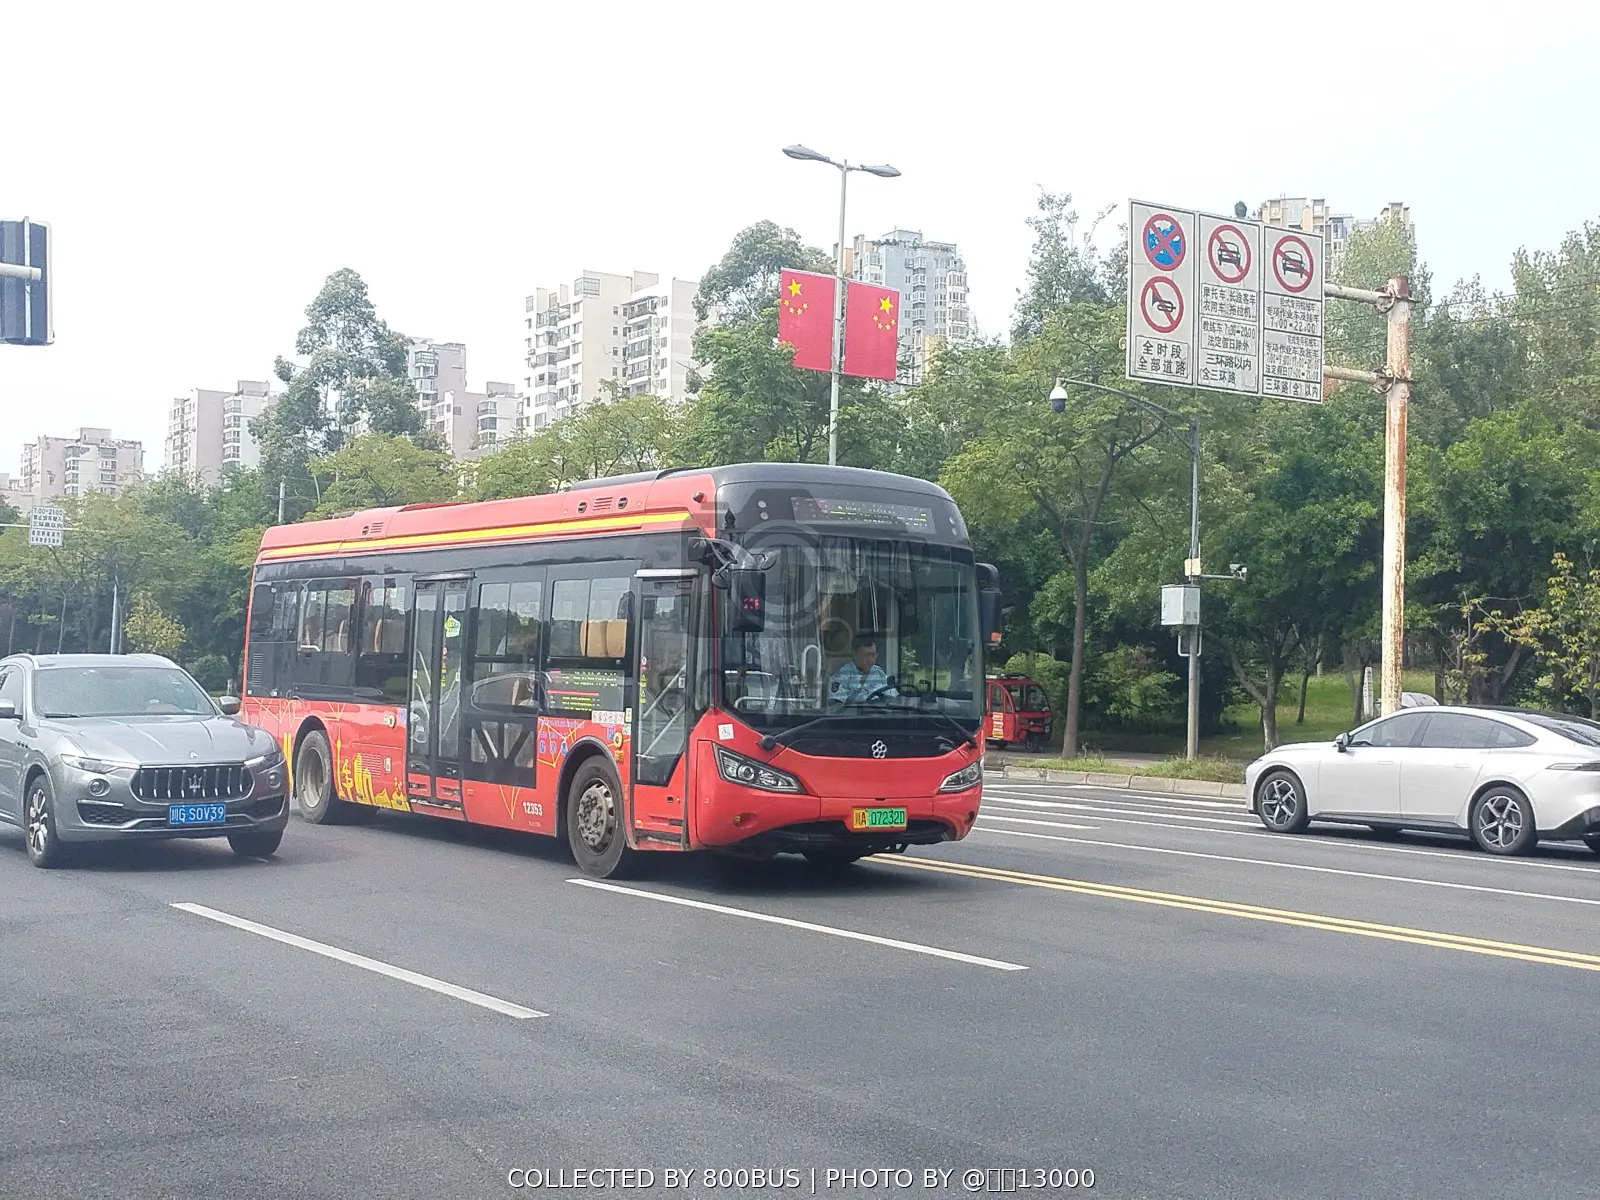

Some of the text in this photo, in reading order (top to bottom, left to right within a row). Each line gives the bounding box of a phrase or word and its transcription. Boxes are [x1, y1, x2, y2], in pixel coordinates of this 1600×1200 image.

[1142, 340, 1182, 359] 全时段
[1137, 355, 1186, 376] 全部道路
[1206, 353, 1252, 372] 三环路以内
[522, 801, 543, 816] 12353
